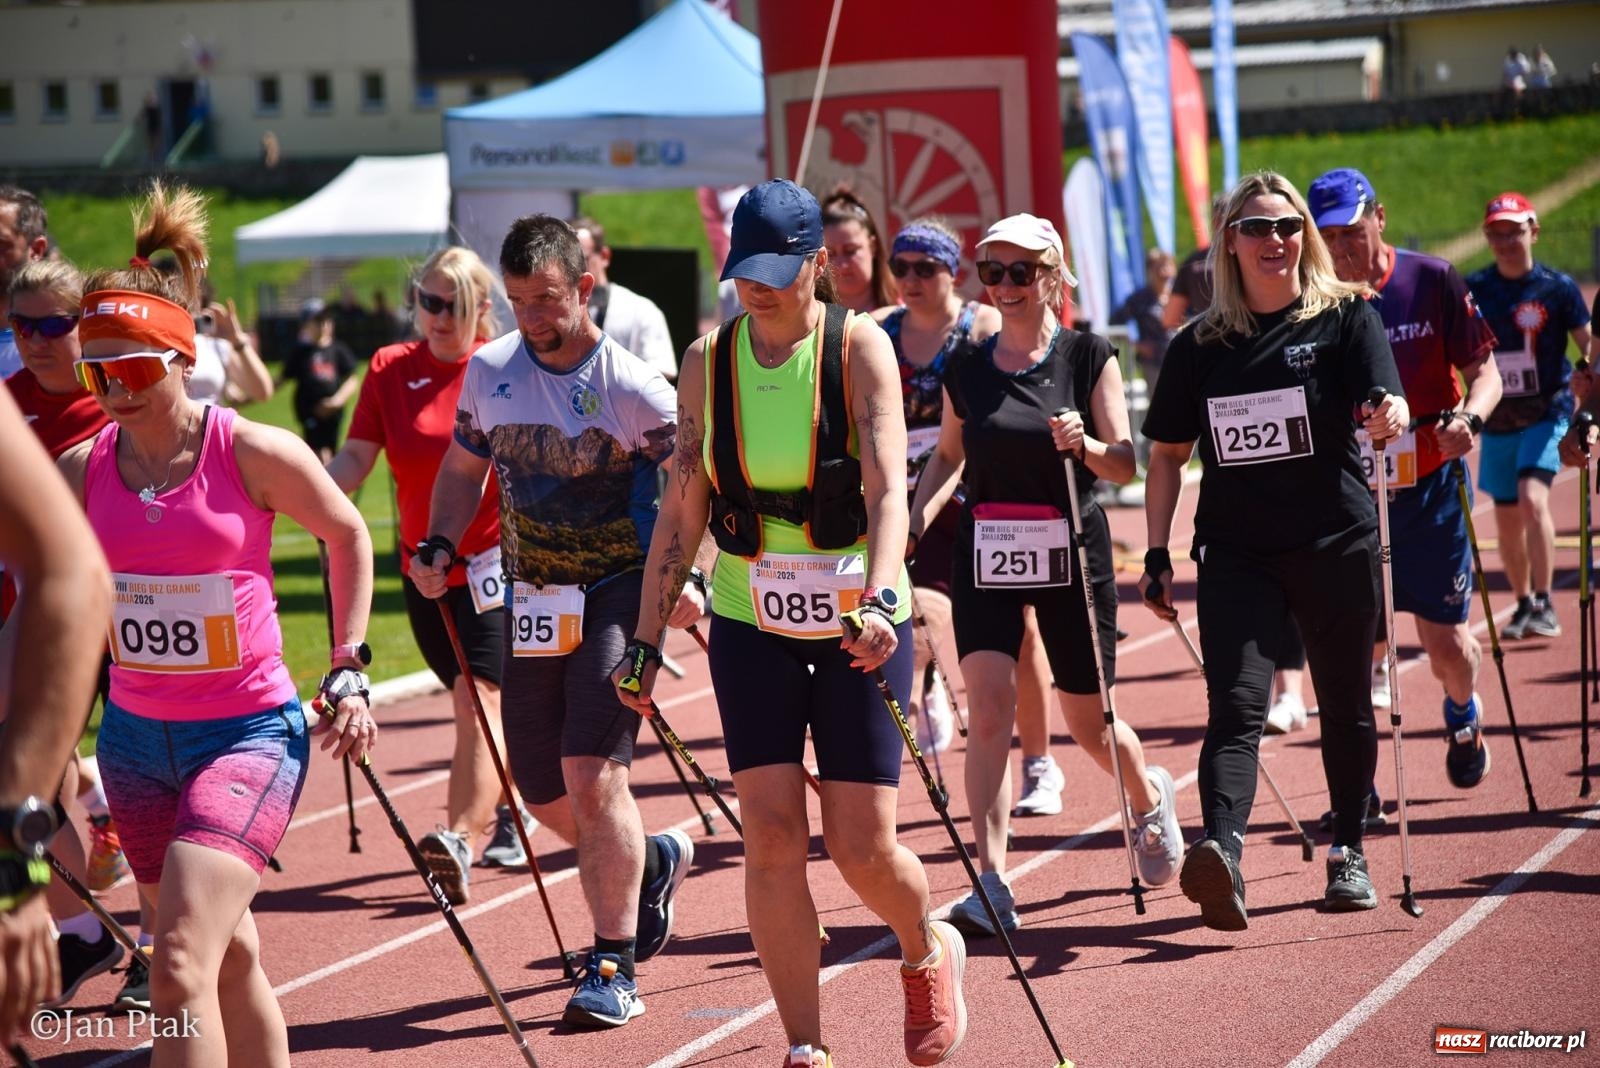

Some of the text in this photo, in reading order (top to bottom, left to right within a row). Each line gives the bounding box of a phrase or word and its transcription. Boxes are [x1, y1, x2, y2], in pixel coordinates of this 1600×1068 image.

[83, 303, 149, 320] LEKI
[1225, 421, 1282, 453] 252
[772, 561, 789, 570] BIEG
[791, 562, 805, 570] BEZ
[991, 550, 1038, 576] 251
[129, 583, 147, 593] BIEG
[148, 584, 163, 594] BEZ
[165, 582, 201, 594] GRANIC
[763, 591, 834, 624] 085
[120, 618, 199, 656] 098
